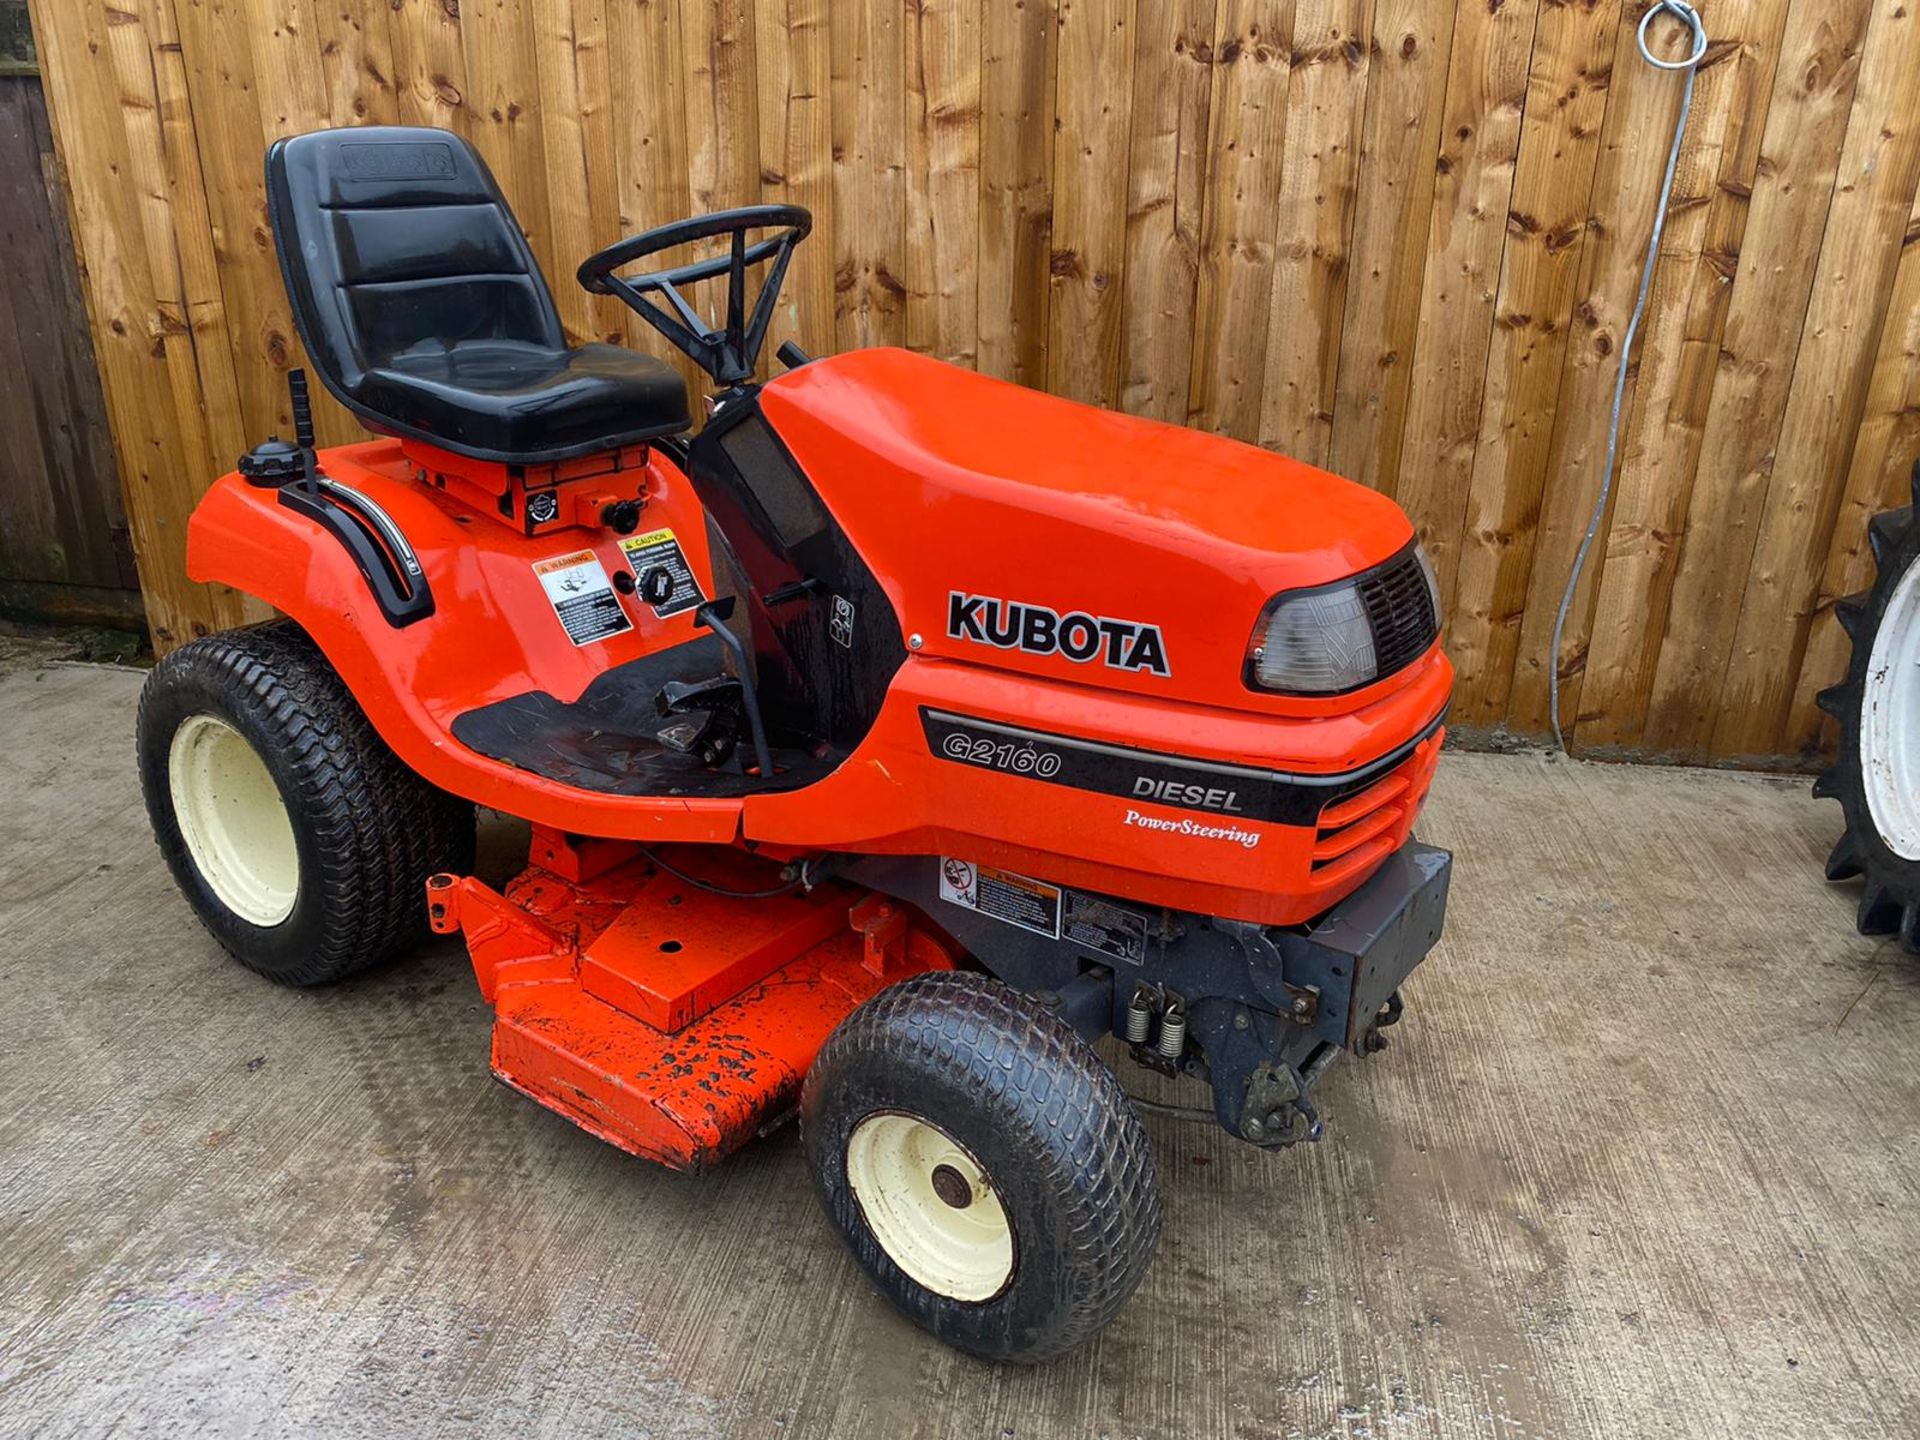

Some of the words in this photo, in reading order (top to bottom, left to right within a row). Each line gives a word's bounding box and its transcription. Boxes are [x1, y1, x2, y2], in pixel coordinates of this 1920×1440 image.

[635, 533, 667, 546] CAUTION
[552, 553, 589, 569] WARNING
[948, 592, 1170, 676] KUBOTA
[943, 733, 1061, 777] G2160
[1133, 777, 1242, 811] DIESEL
[1123, 809, 1260, 847] PowerSteering
